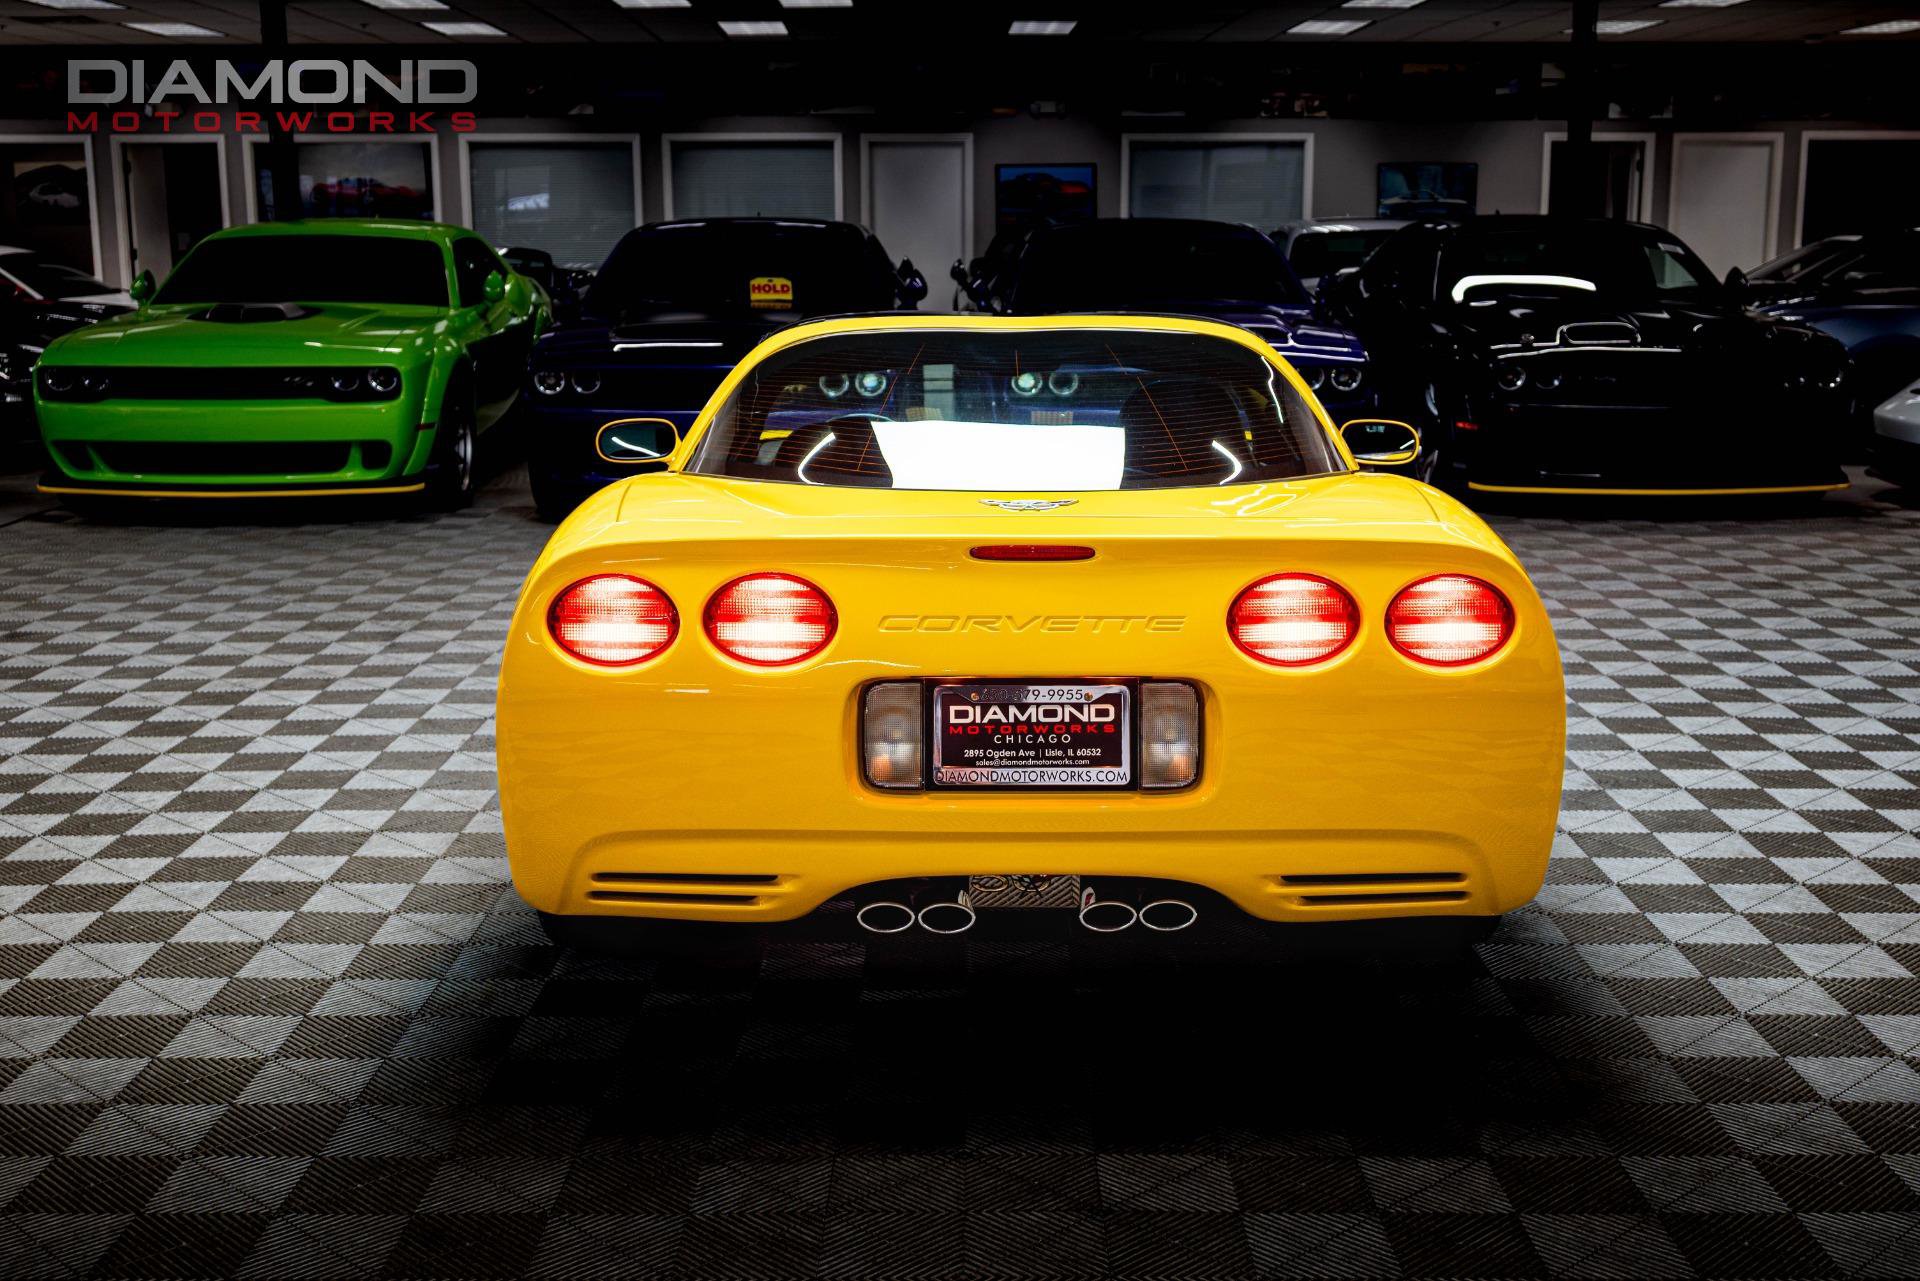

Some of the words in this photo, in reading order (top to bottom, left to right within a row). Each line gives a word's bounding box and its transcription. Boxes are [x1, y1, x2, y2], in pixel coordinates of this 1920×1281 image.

[751, 283, 791, 294] HOLD
[878, 614, 1187, 634] CORVETTE
[949, 704, 1115, 724] DIAMOND
[949, 724, 1115, 735] MOTORWORKS
[994, 734, 1071, 744] CHICAGO
[964, 749, 984, 758] 2895
[986, 749, 1016, 759] Ogden
[1018, 749, 1035, 757] Ave
[1067, 748, 1075, 756] IL
[1076, 748, 1101, 757] 60532
[975, 758, 1090, 767] sales@diamondmotorworks.com
[935, 770, 1128, 783] DIAMONDMOTORWORKS.COM
